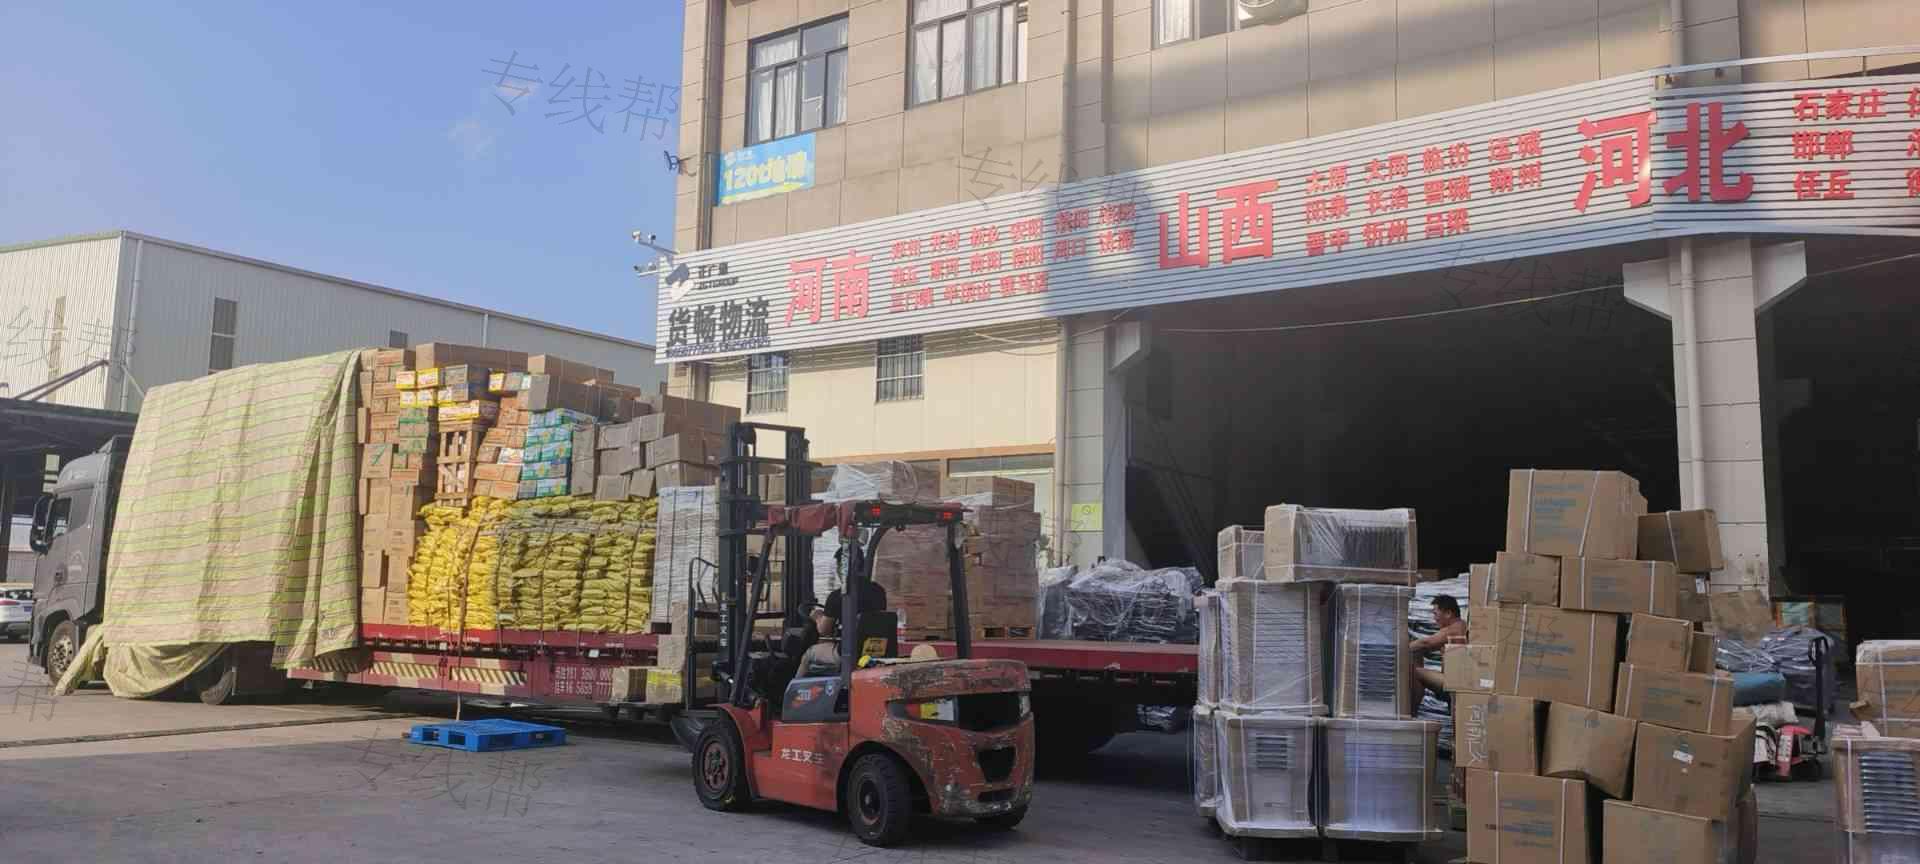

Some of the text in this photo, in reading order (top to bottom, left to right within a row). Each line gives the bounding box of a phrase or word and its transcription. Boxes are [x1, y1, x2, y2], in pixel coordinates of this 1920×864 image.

[1792, 88, 1888, 121] 石家庄
[1306, 128, 1543, 194] 太原 大同 临汾 运城
[1574, 101, 1754, 213] 河北
[1792, 130, 1855, 161] 邯郸
[1305, 160, 1543, 224] 阳泉 长治 晋城 朔州
[1793, 168, 1855, 201] 任丘
[1159, 179, 1280, 270] 山西
[1305, 207, 1470, 256] 晋中 忻州 吕梁
[785, 249, 874, 327] 河南
[668, 297, 769, 348] 货畅物流
